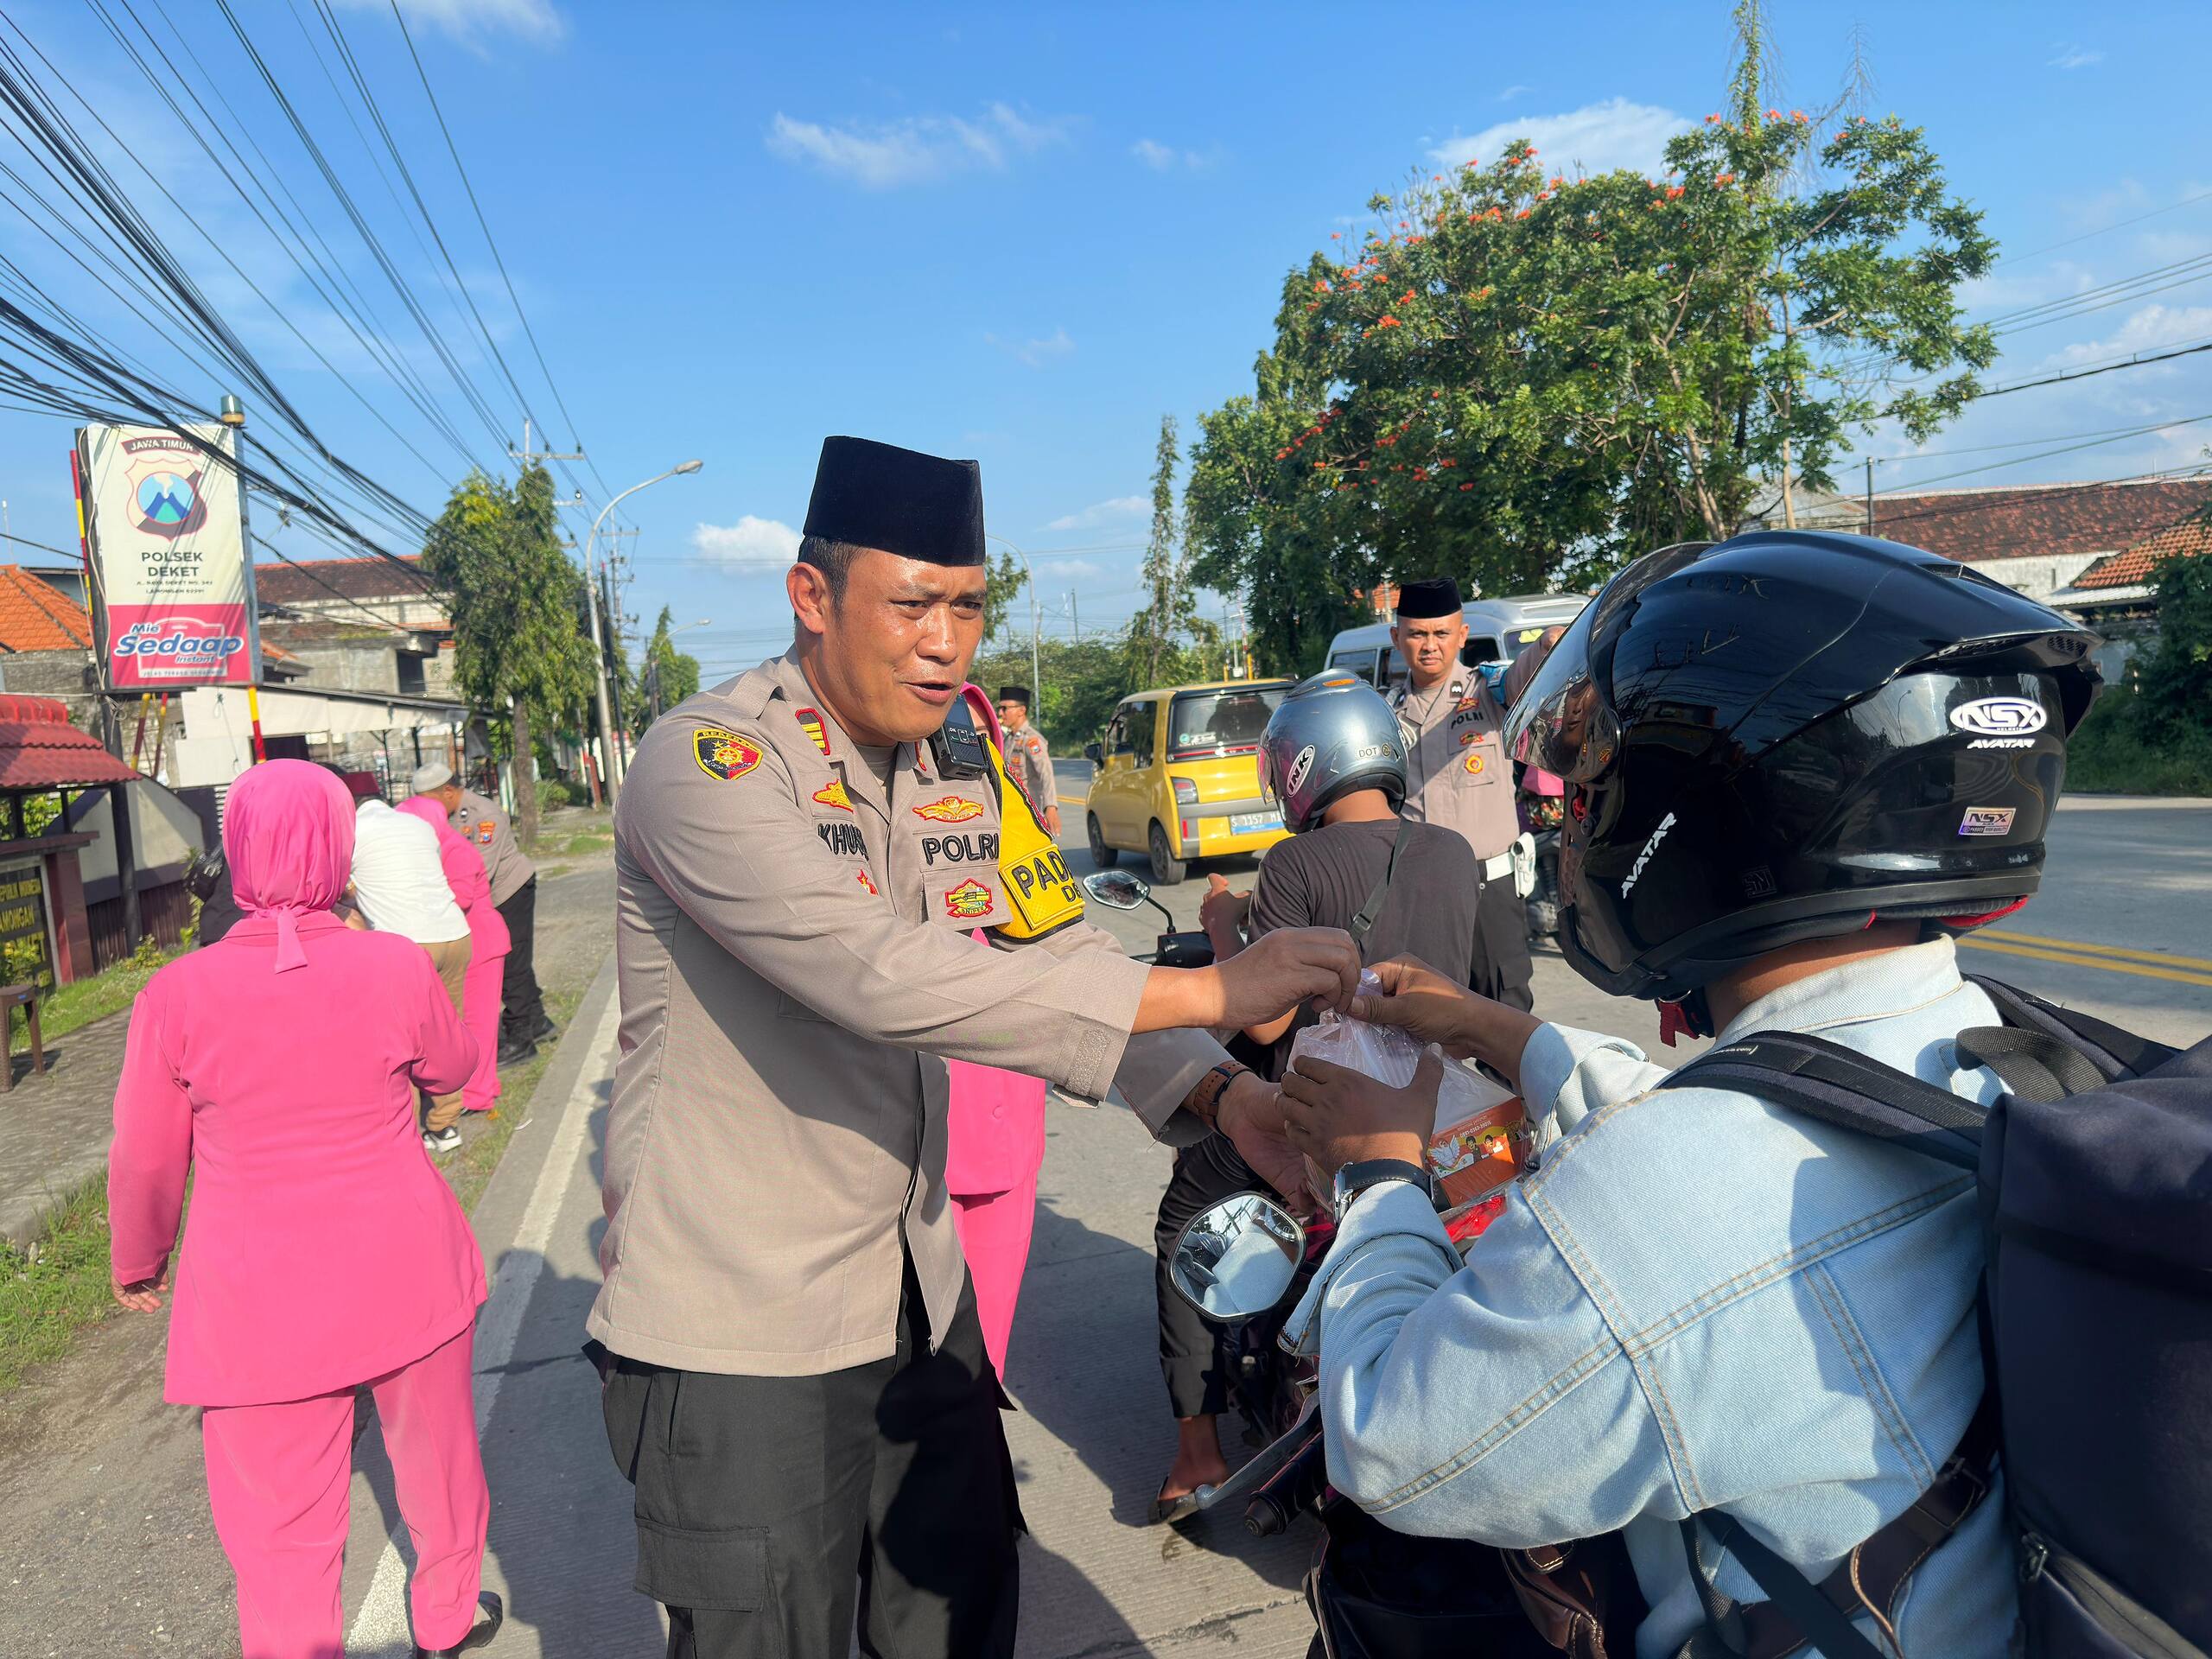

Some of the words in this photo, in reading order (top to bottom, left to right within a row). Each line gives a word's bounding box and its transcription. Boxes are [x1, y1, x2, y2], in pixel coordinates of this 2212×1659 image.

[130, 435, 161, 451] JAWA
[161, 435, 194, 452] TIMUR
[141, 551, 204, 563] POLSEK
[148, 566, 200, 577] DEKET
[130, 623, 161, 634] Mie
[115, 632, 243, 658] Sedaap
[175, 655, 216, 664] Instant
[1961, 703, 2041, 728] NSX
[1966, 738, 2037, 749] AVATAR
[1357, 746, 1379, 759] DOT
[1288, 749, 1310, 794] INK
[1968, 812, 2007, 823] NSX
[921, 832, 1000, 867] POLRI
[1620, 811, 1677, 899] AVATAR
[1011, 850, 1074, 899] PAD
